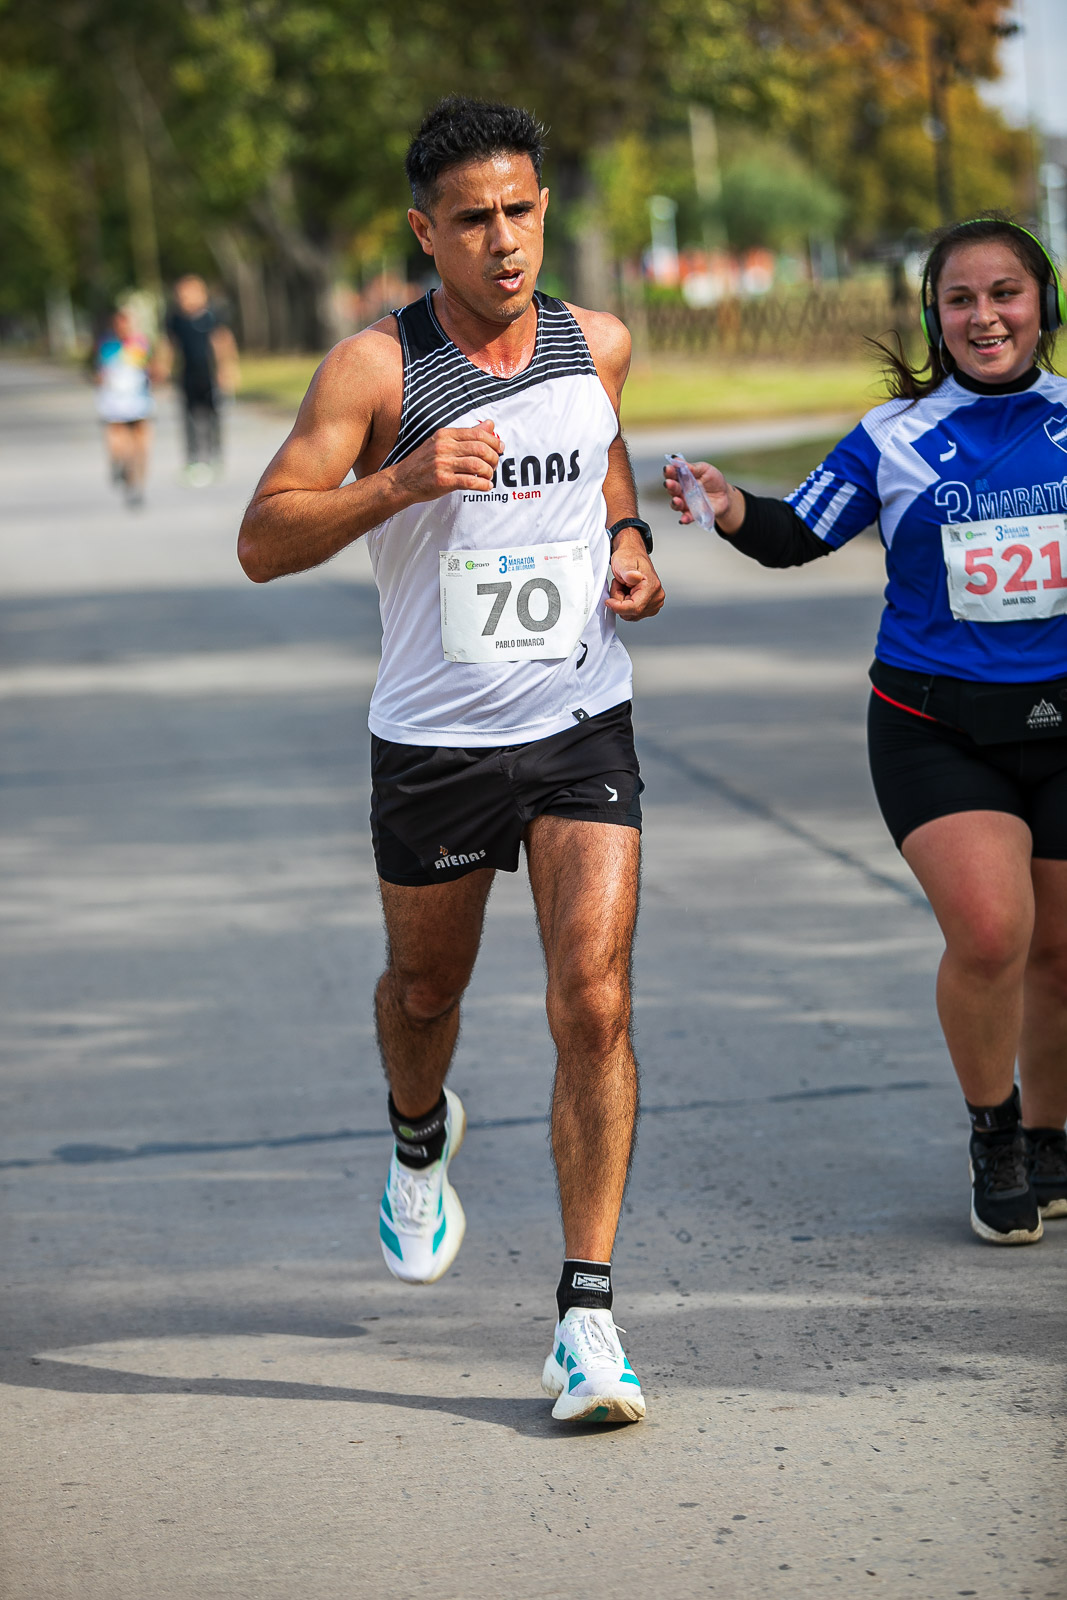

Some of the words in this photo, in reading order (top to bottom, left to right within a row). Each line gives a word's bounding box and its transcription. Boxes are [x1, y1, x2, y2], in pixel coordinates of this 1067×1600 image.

[463, 491, 509, 503] running
[512, 490, 541, 500] team
[995, 525, 1004, 541] 3
[498, 555, 508, 574] 3
[964, 541, 1067, 595] 521
[477, 577, 561, 636] 70
[495, 640, 515, 649] PABLO
[516, 638, 545, 648] DIMARCO
[434, 849, 486, 869] ATENAS
